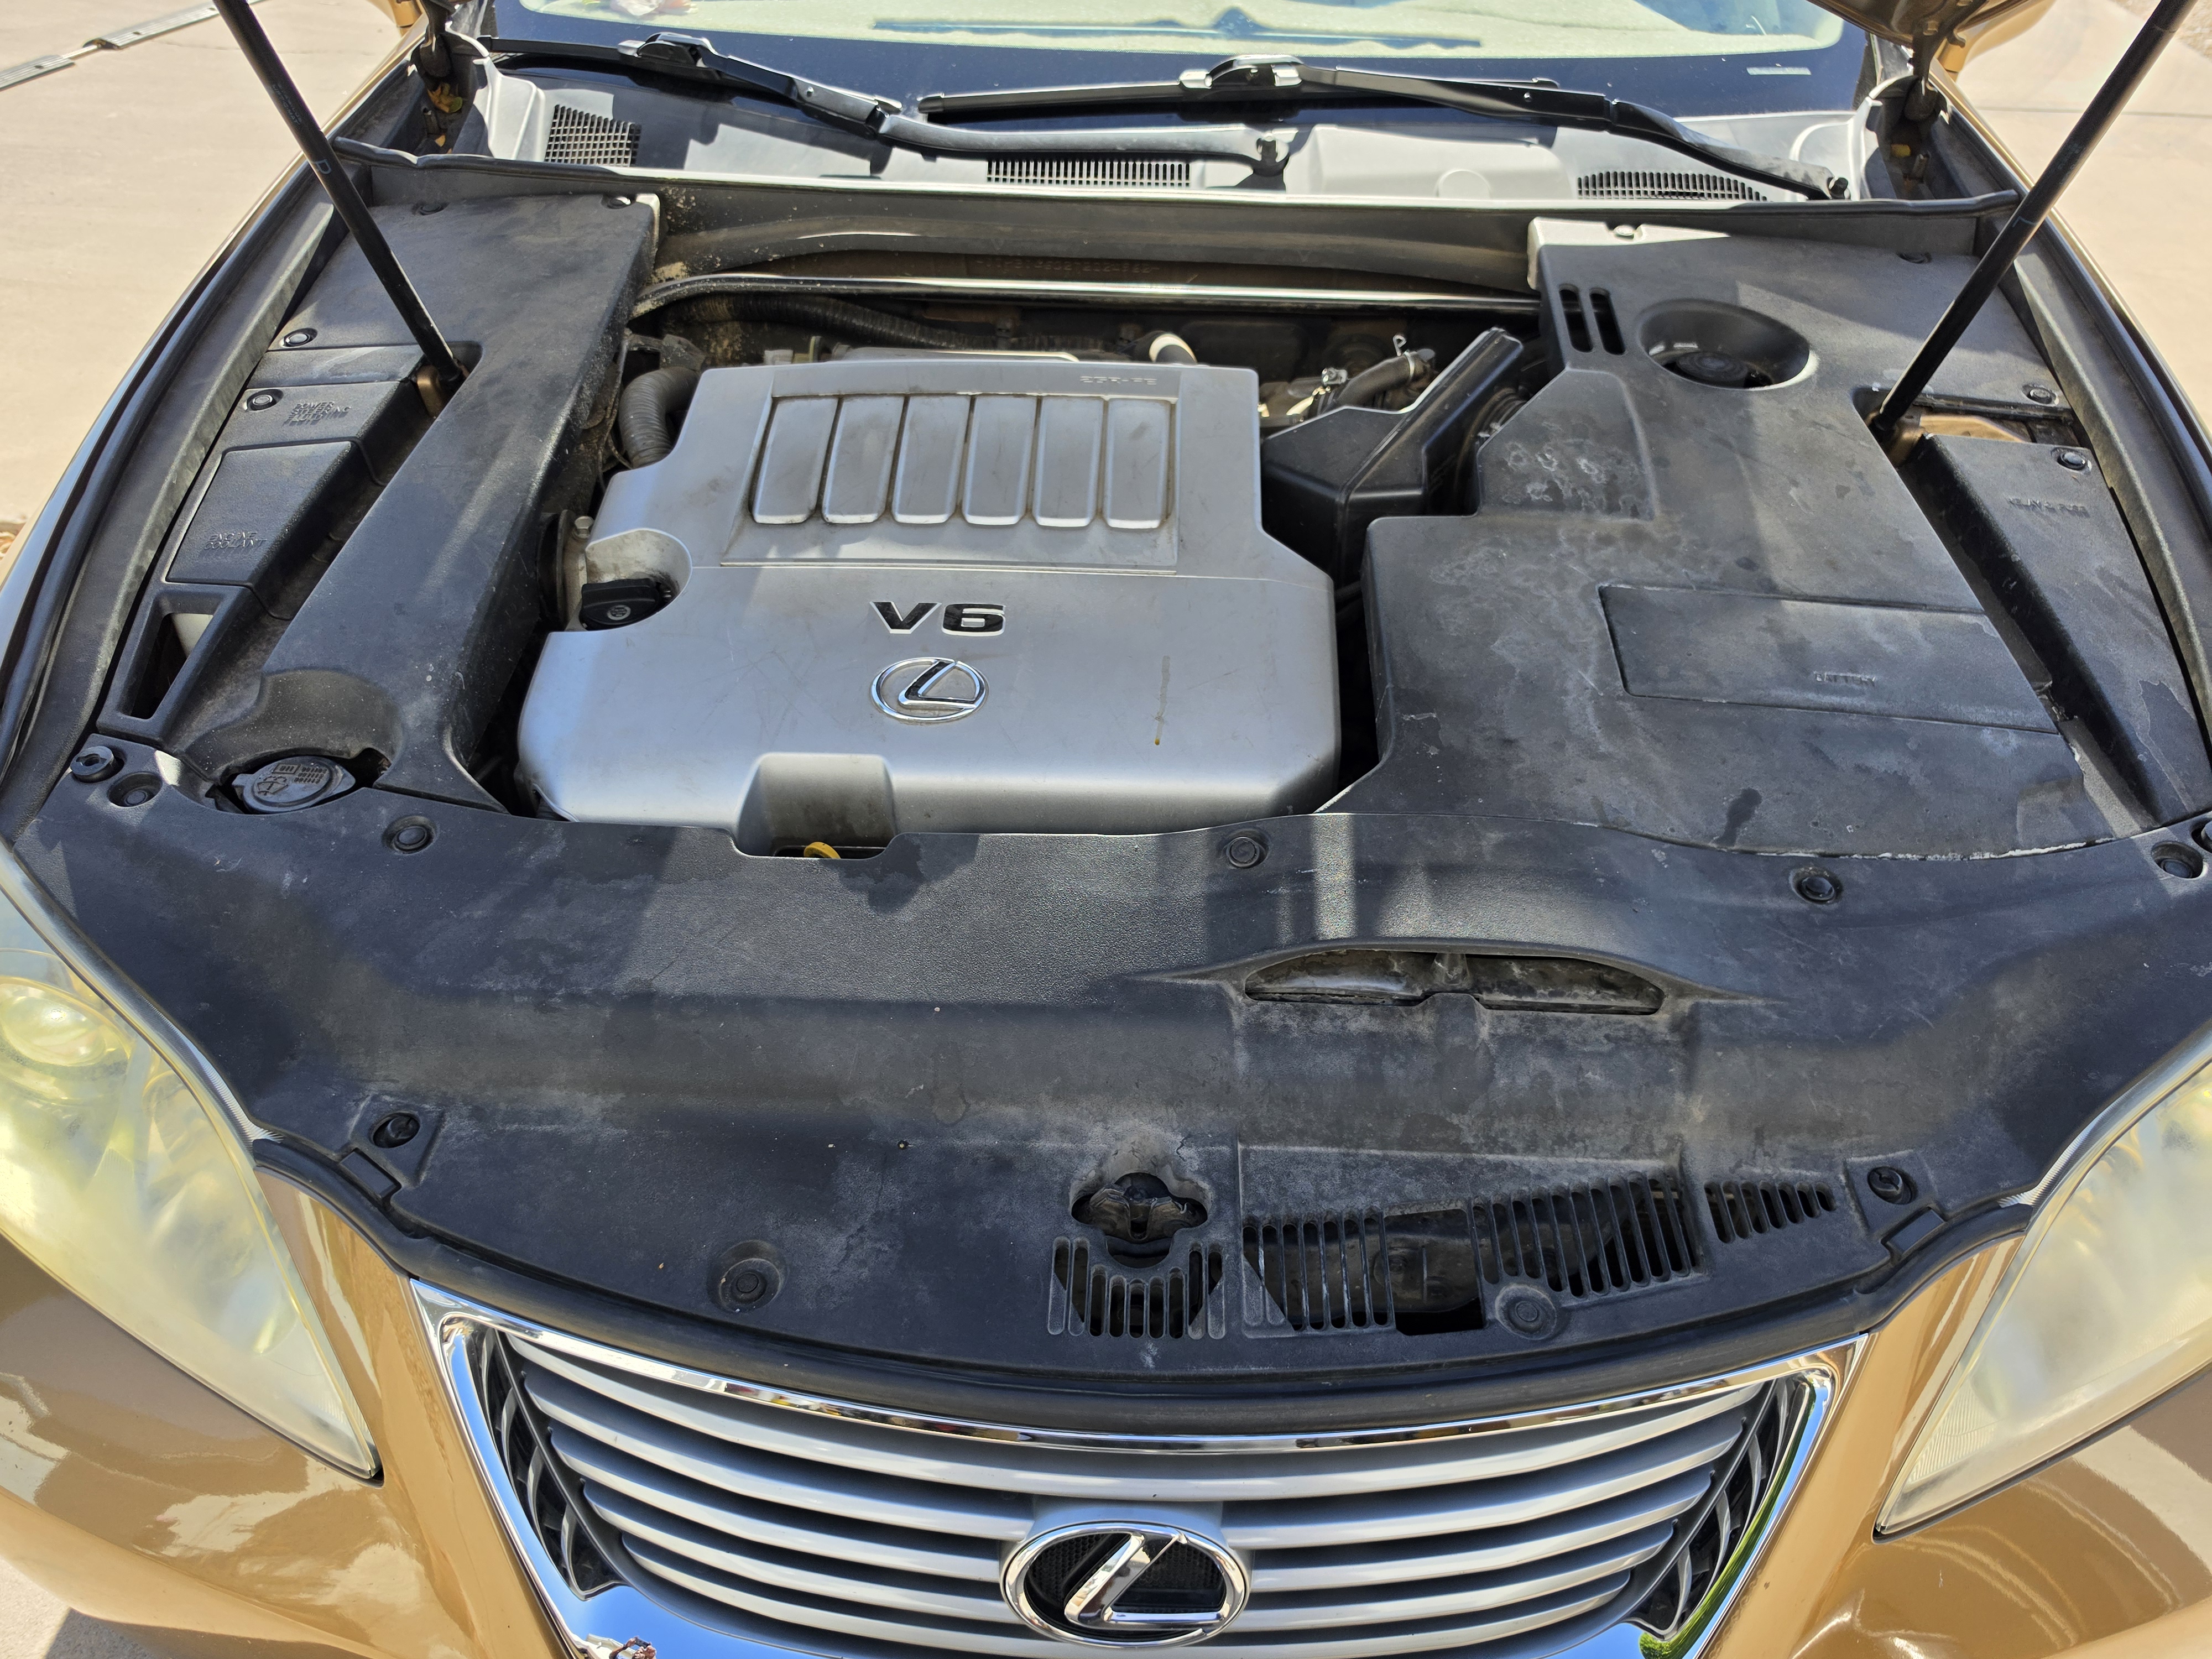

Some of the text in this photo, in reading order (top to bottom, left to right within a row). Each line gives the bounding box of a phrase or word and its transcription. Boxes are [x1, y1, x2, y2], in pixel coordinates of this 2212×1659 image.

[295, 400, 336, 410] POWER
[290, 406, 352, 416] STEERING
[208, 531, 258, 541] ENGINE
[204, 538, 268, 551] COOLANT
[869, 601, 1006, 637] V6
[1813, 670, 1876, 687] BATTERY
